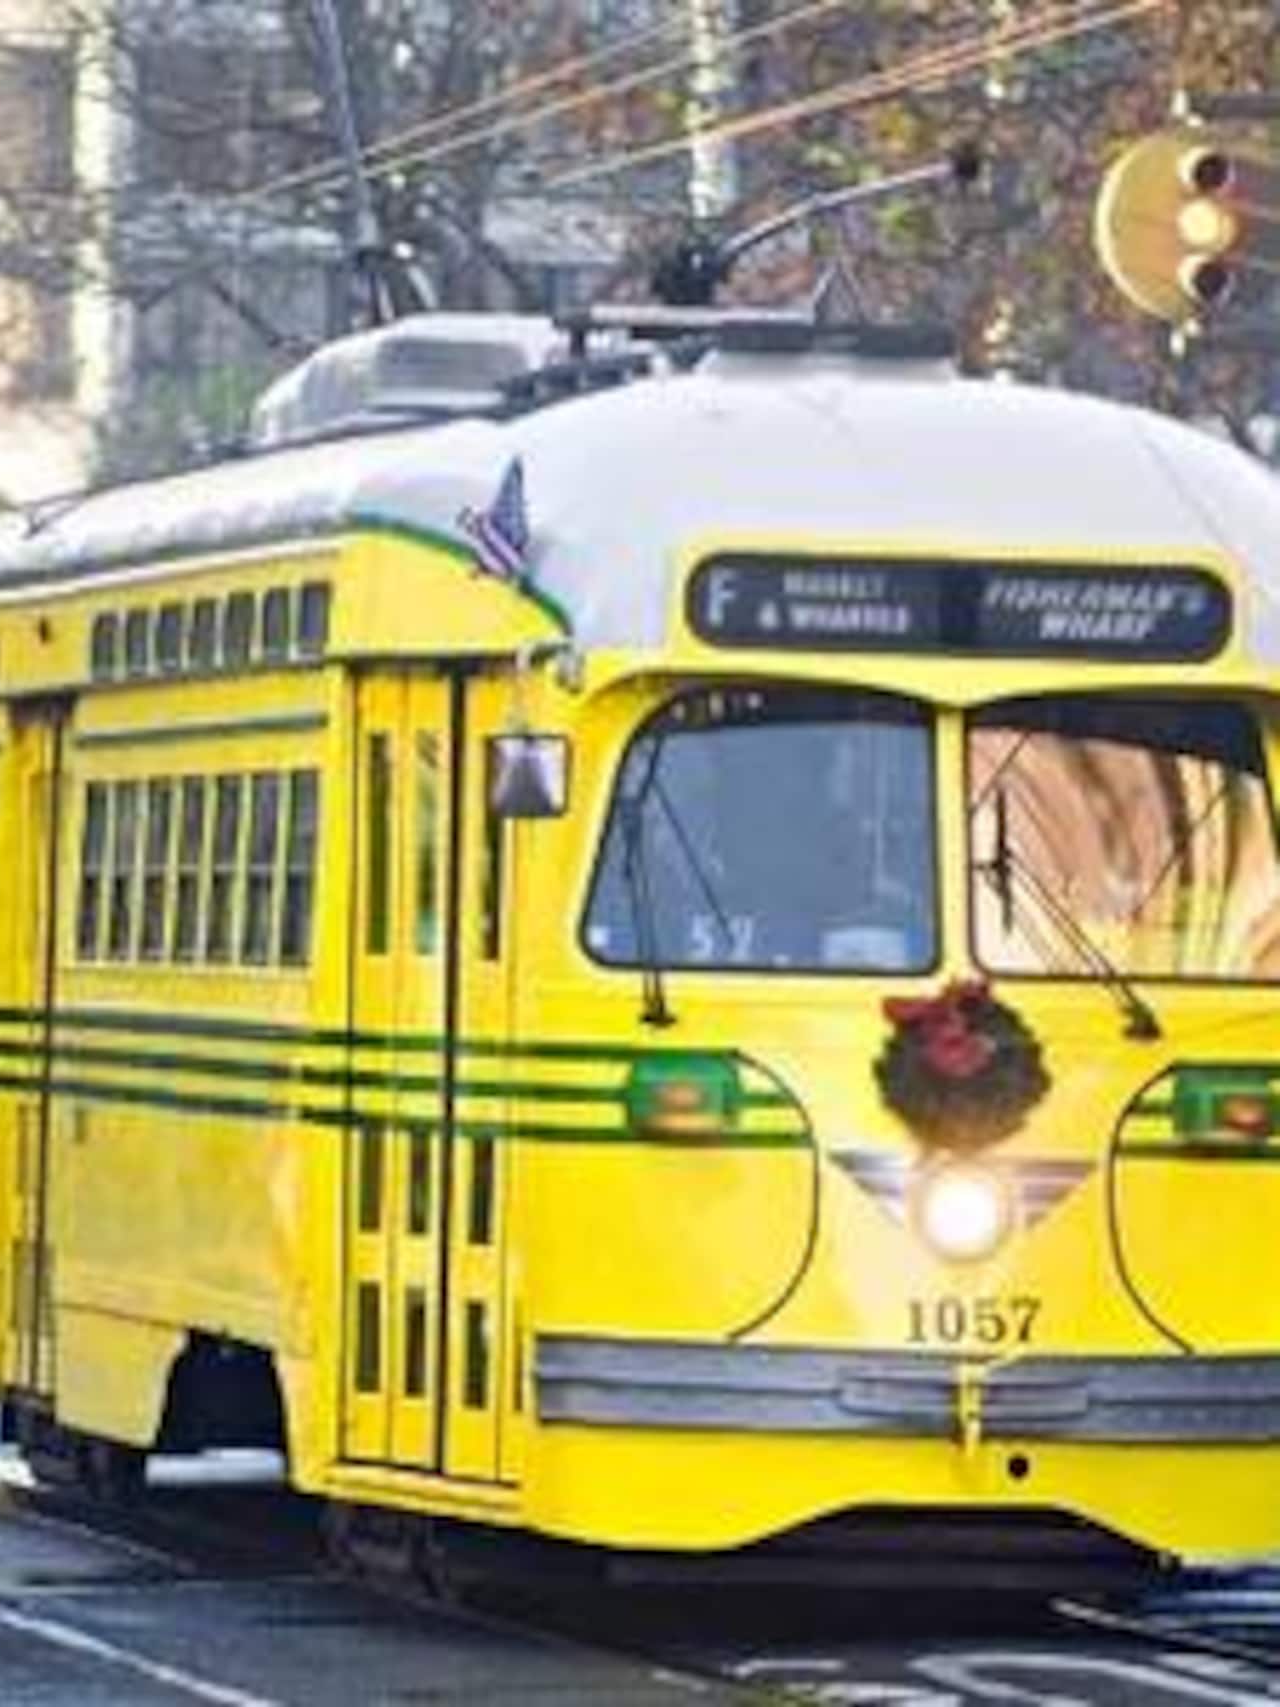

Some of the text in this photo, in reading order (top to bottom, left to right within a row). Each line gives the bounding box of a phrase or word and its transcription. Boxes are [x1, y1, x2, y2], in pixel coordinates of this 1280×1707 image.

[708, 567, 738, 628] F
[1039, 611, 1156, 640] WHARF
[906, 1296, 1043, 1343] 1057
